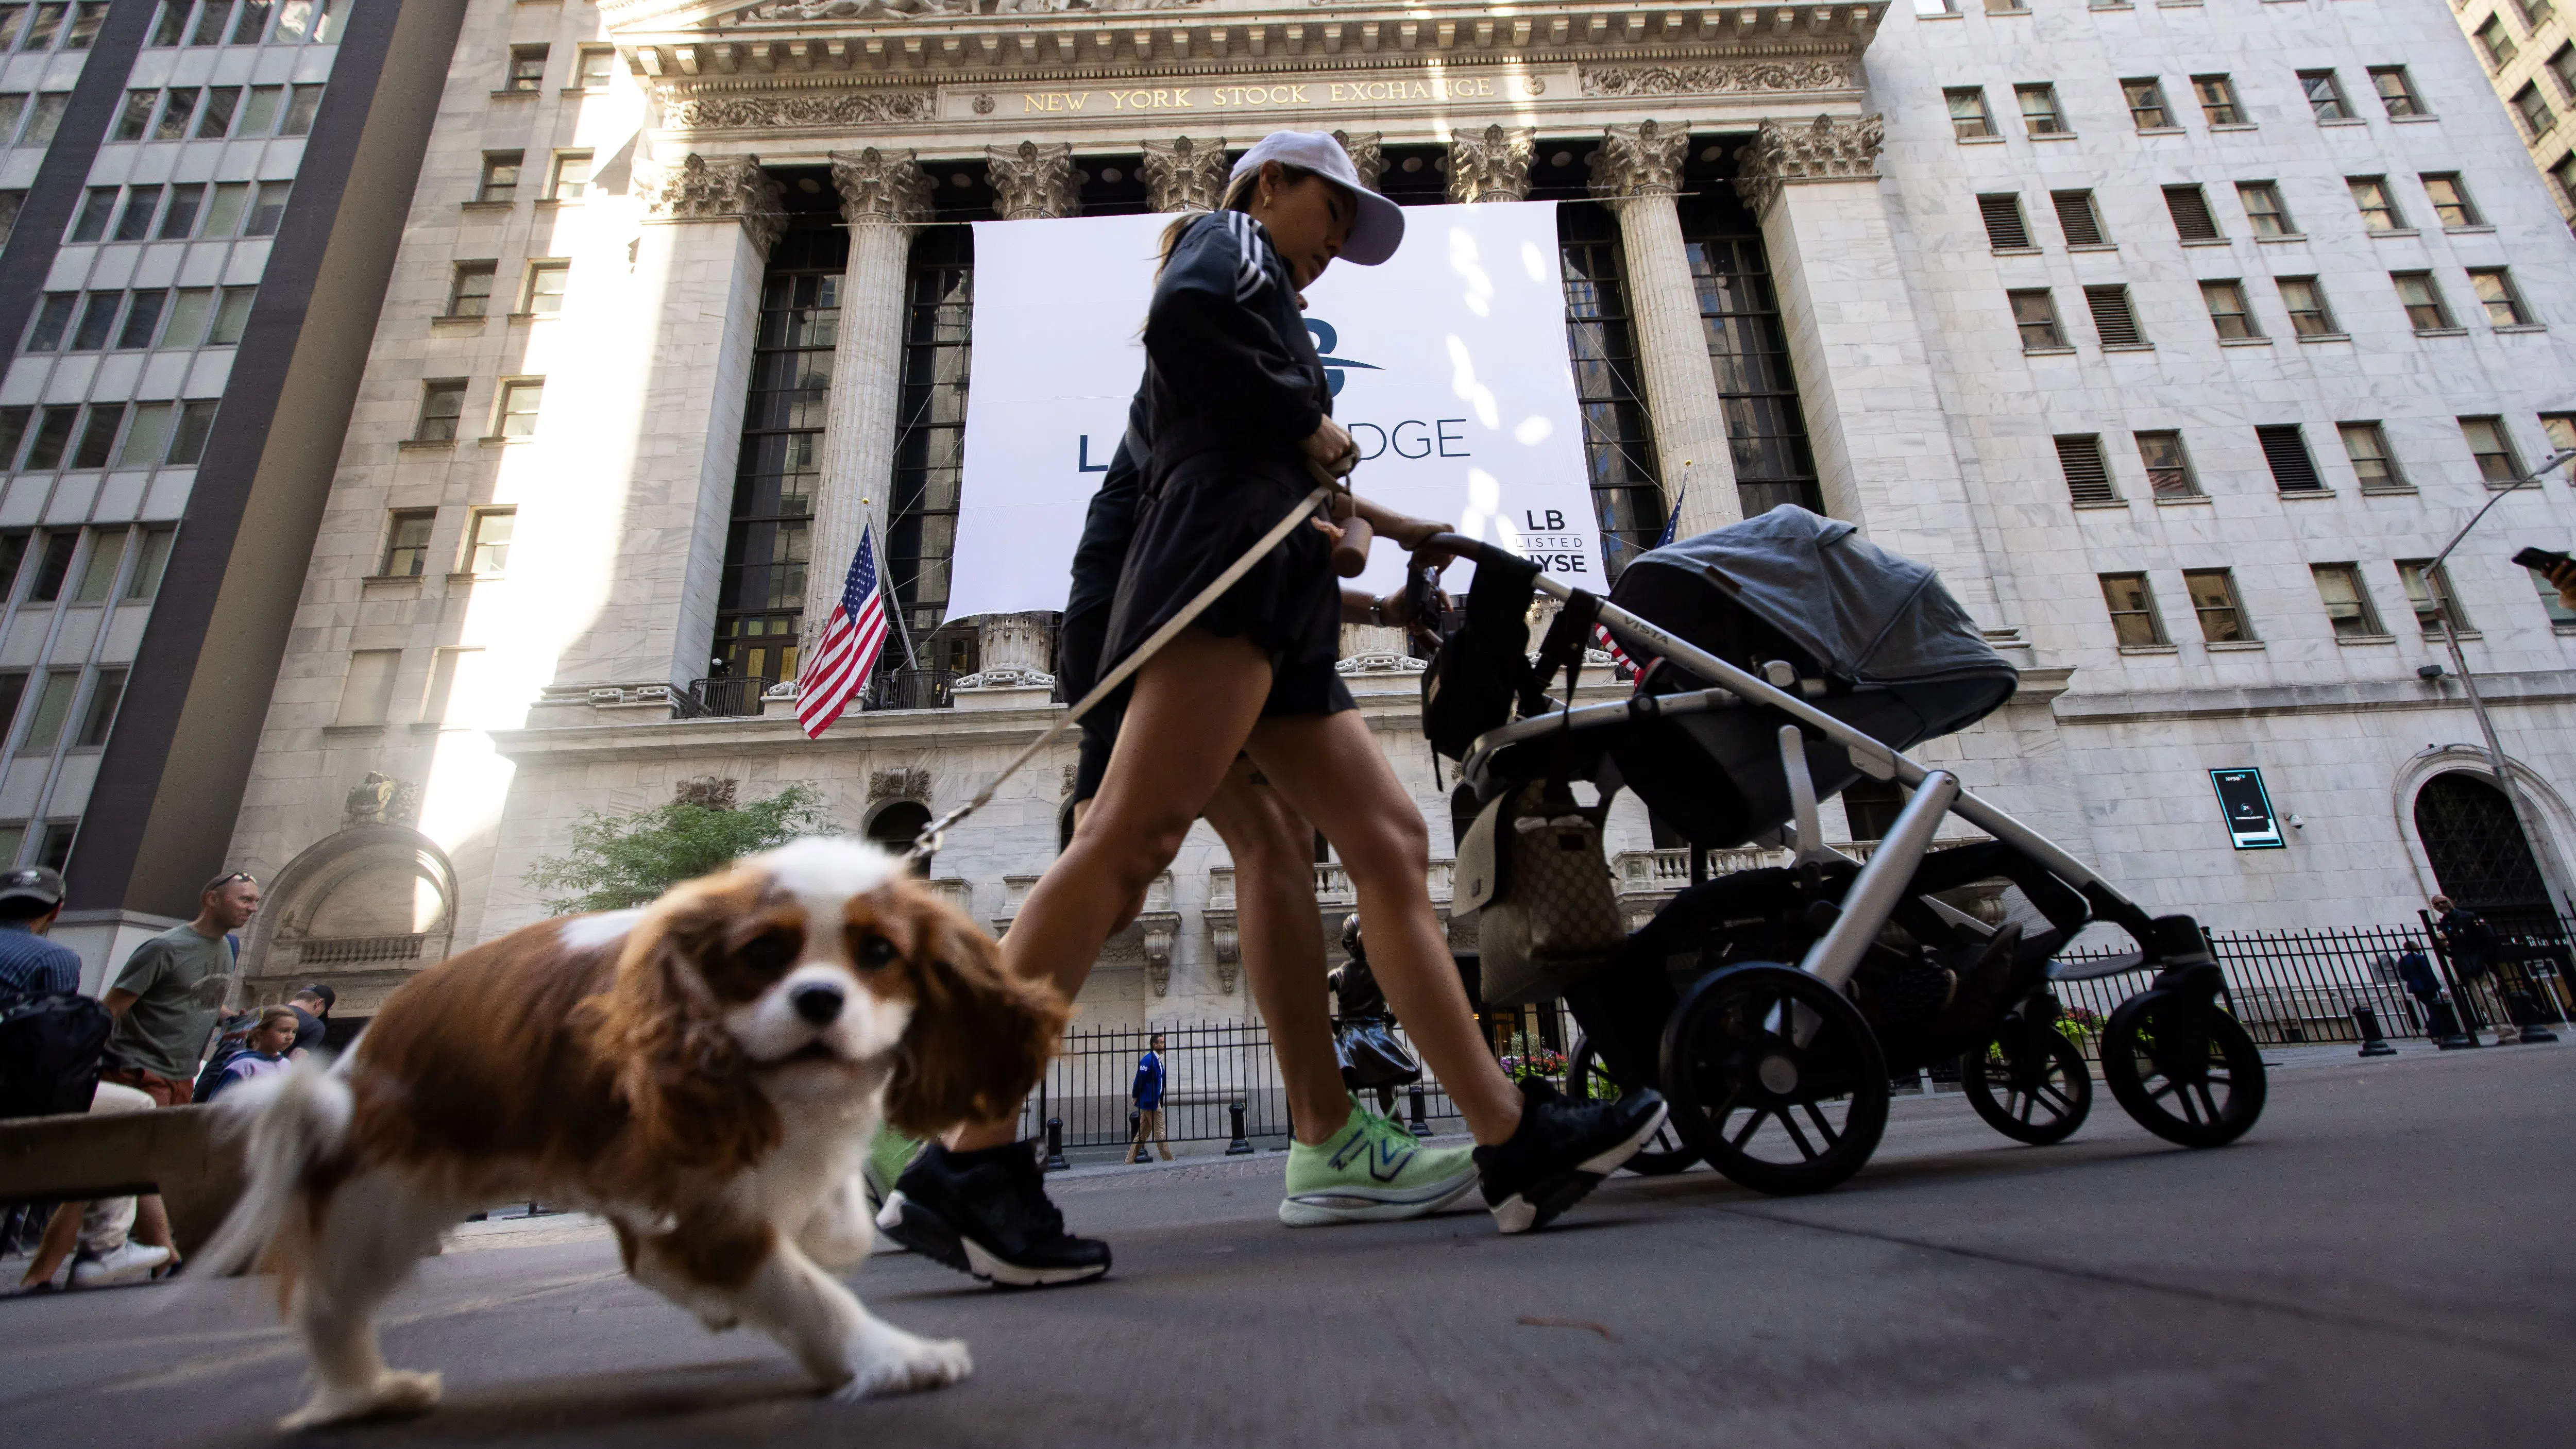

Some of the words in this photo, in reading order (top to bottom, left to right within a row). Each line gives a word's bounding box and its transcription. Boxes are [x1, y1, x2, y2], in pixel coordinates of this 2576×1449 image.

[1023, 92, 1090, 112] NEW
[1109, 88, 1193, 110] YORK
[1213, 86, 1310, 106] STOCK
[1329, 78, 1494, 102] EXCHANGE
[1527, 510, 1565, 530] LB
[1516, 538, 1582, 547] LISTED
[1530, 554, 1587, 572] YSE
[1624, 616, 1669, 644] VISTA
